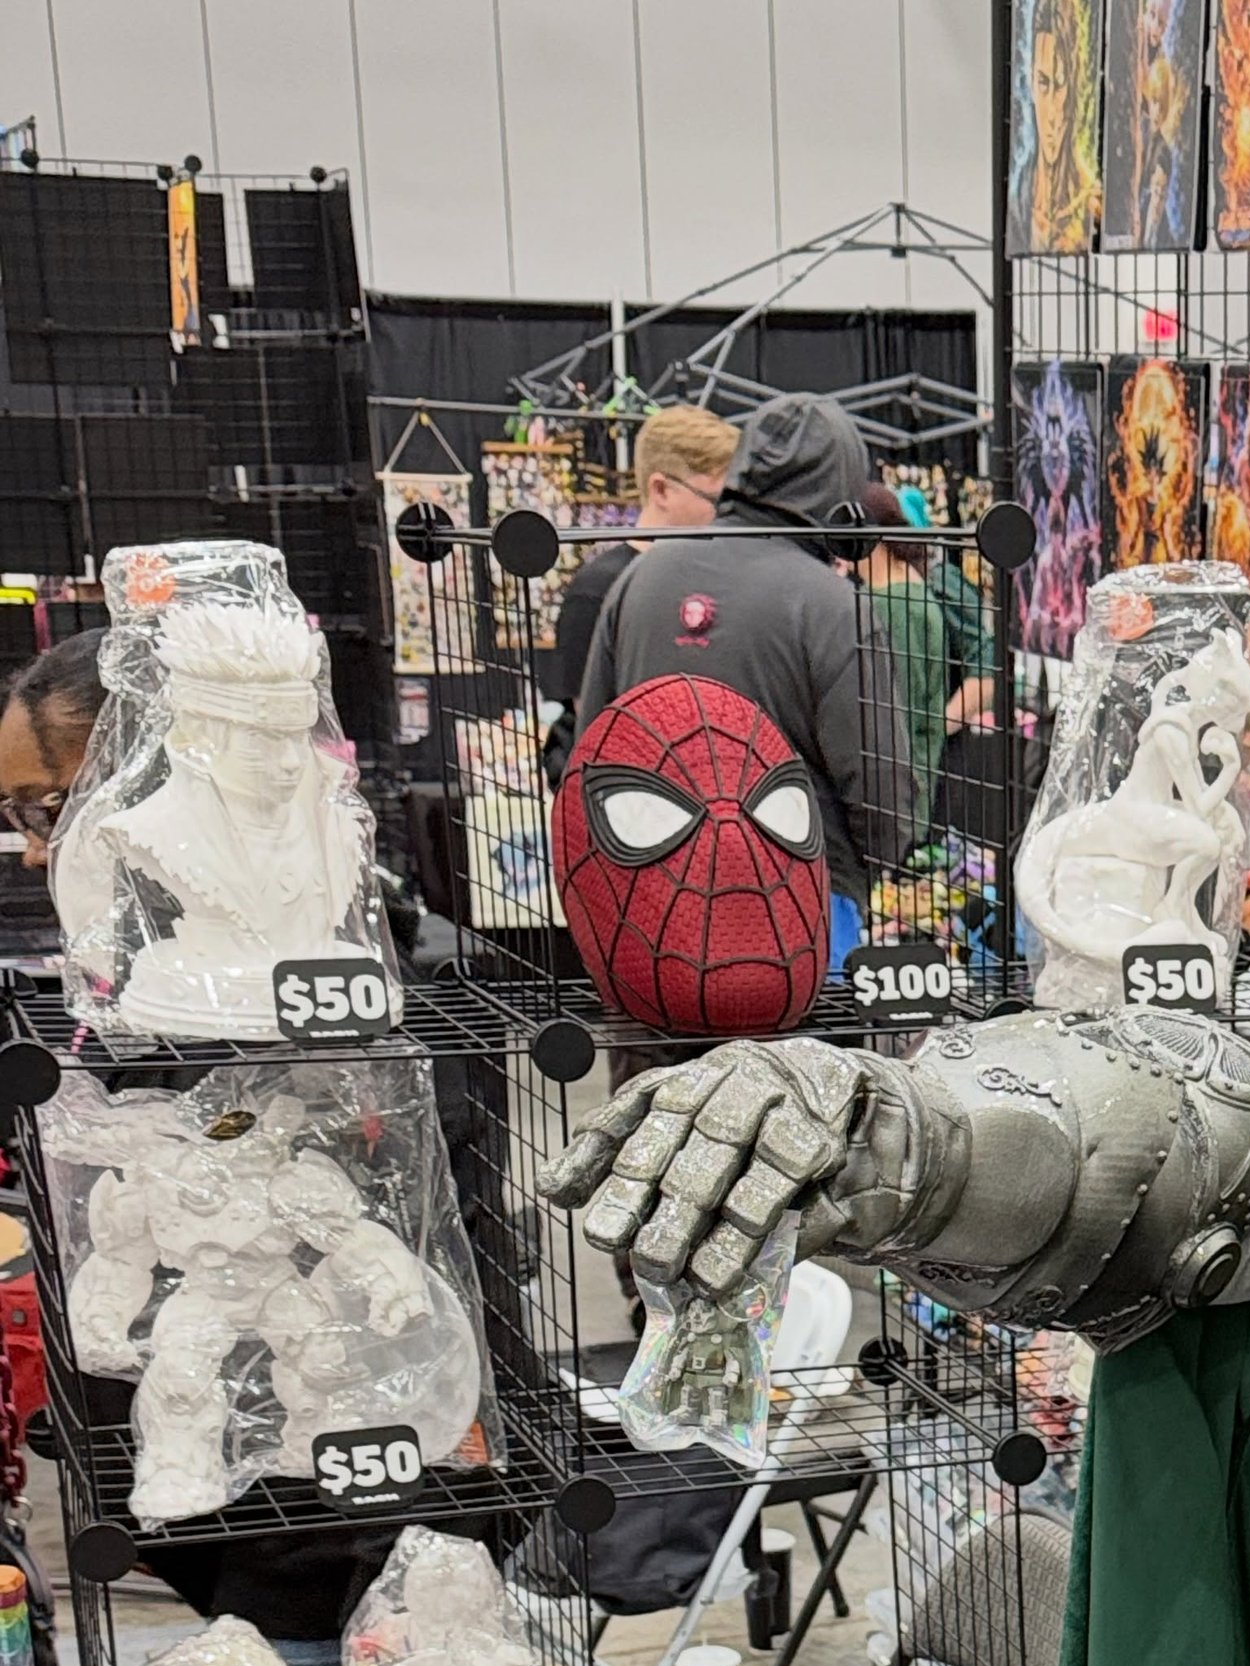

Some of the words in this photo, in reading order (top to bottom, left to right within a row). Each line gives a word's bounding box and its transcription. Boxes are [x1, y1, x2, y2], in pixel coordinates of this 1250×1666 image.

[278, 974, 387, 1028] $50
[853, 963, 951, 1006] $100
[1127, 957, 1215, 1004] $50
[317, 1440, 420, 1496] $50
